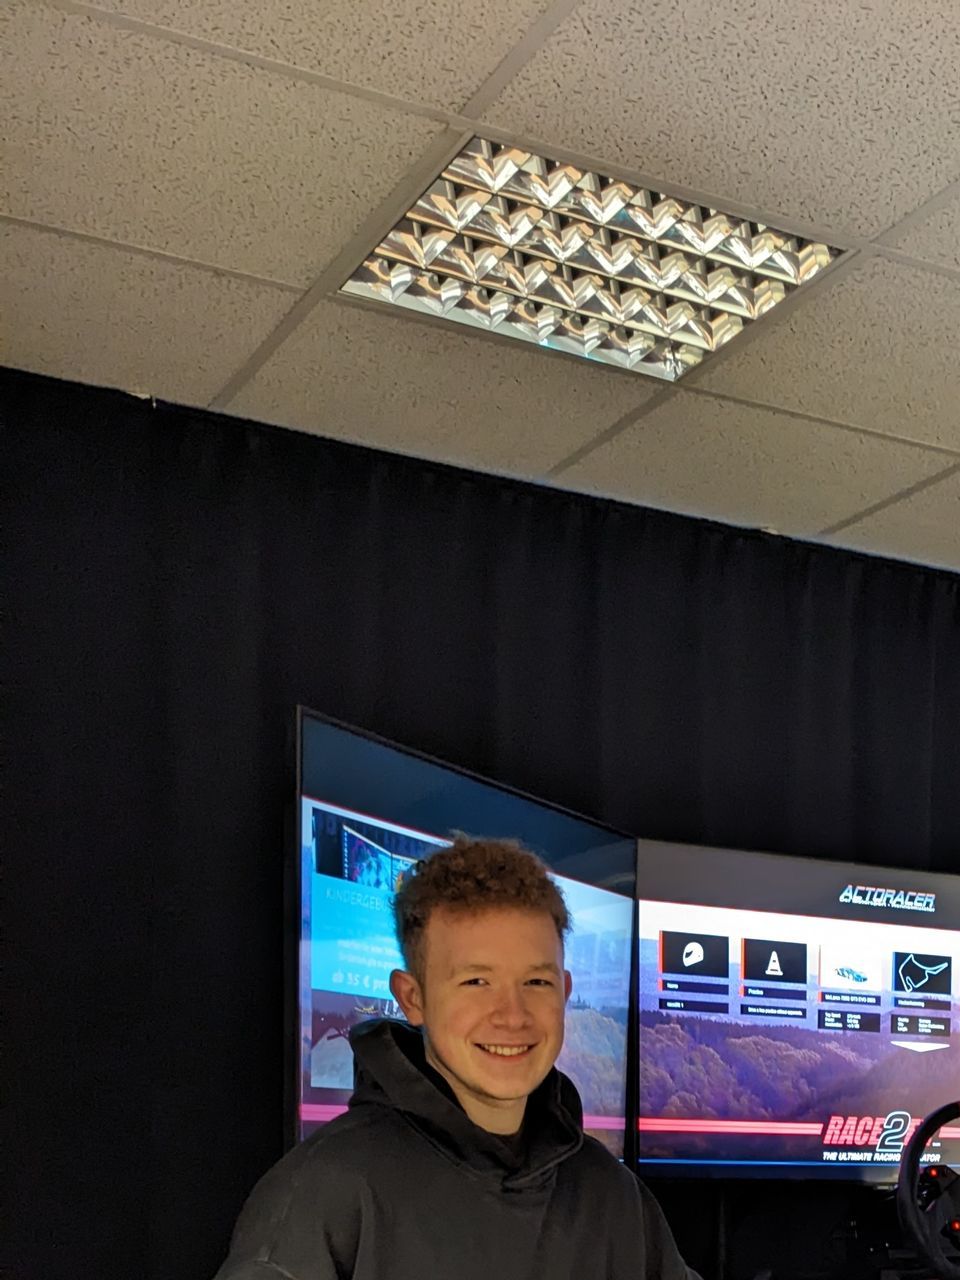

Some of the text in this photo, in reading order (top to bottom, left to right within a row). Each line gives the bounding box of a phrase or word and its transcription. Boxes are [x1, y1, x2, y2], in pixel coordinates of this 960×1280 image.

[839, 884, 936, 908] ACTORACER
[822, 1151, 837, 1161] THE
[838, 1152, 873, 1162] ULTIMATE
